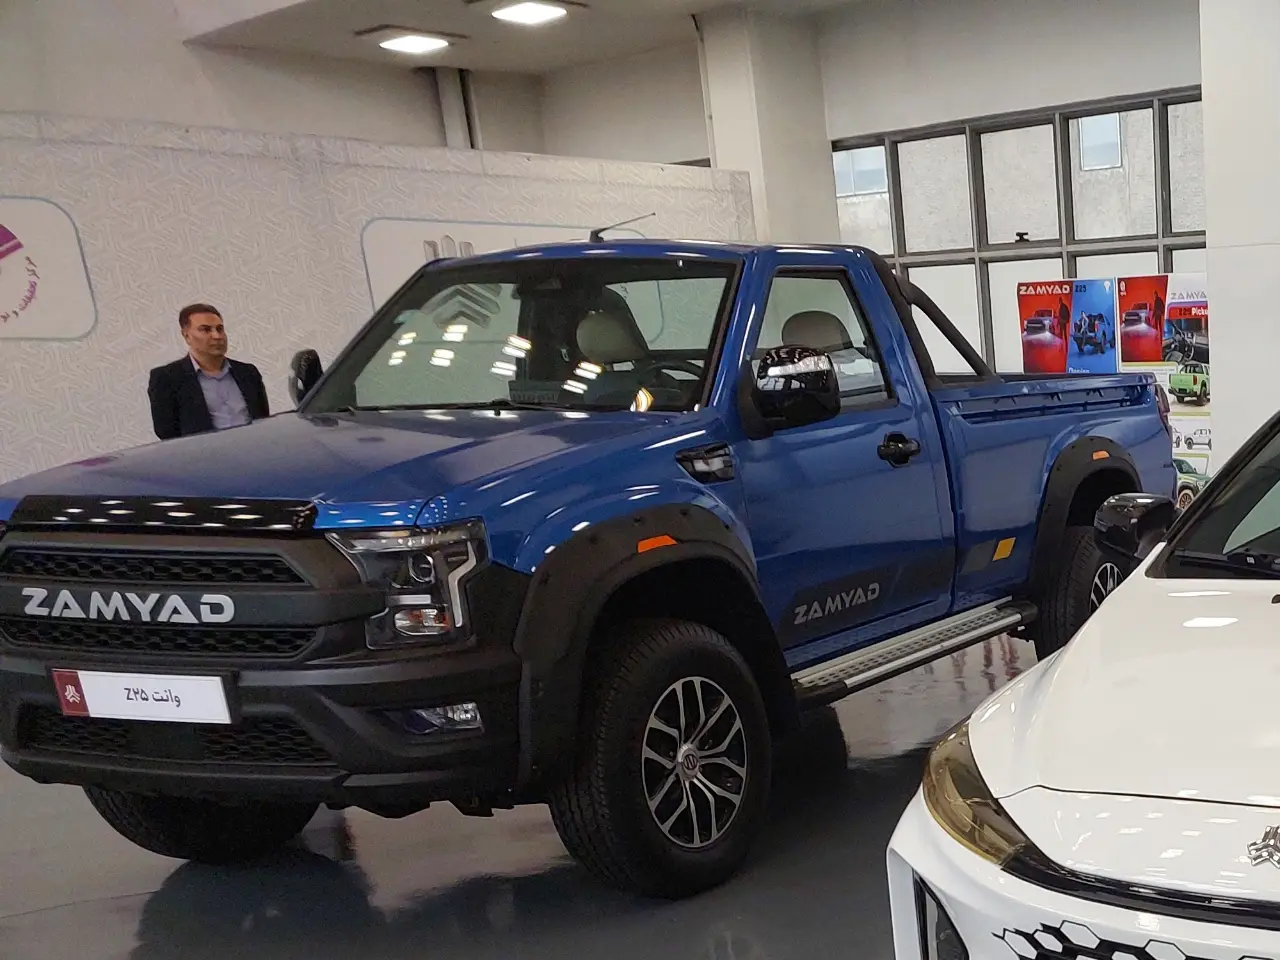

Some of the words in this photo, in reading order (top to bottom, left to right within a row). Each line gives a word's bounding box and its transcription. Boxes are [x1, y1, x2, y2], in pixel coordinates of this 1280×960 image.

[1019, 284, 1071, 295] ZAMYAD
[1171, 291, 1207, 300] ZAMYA
[21, 587, 236, 624] ZAMYAD
[794, 582, 880, 625] ZAMYAD
[151, 688, 181, 708] وانت
